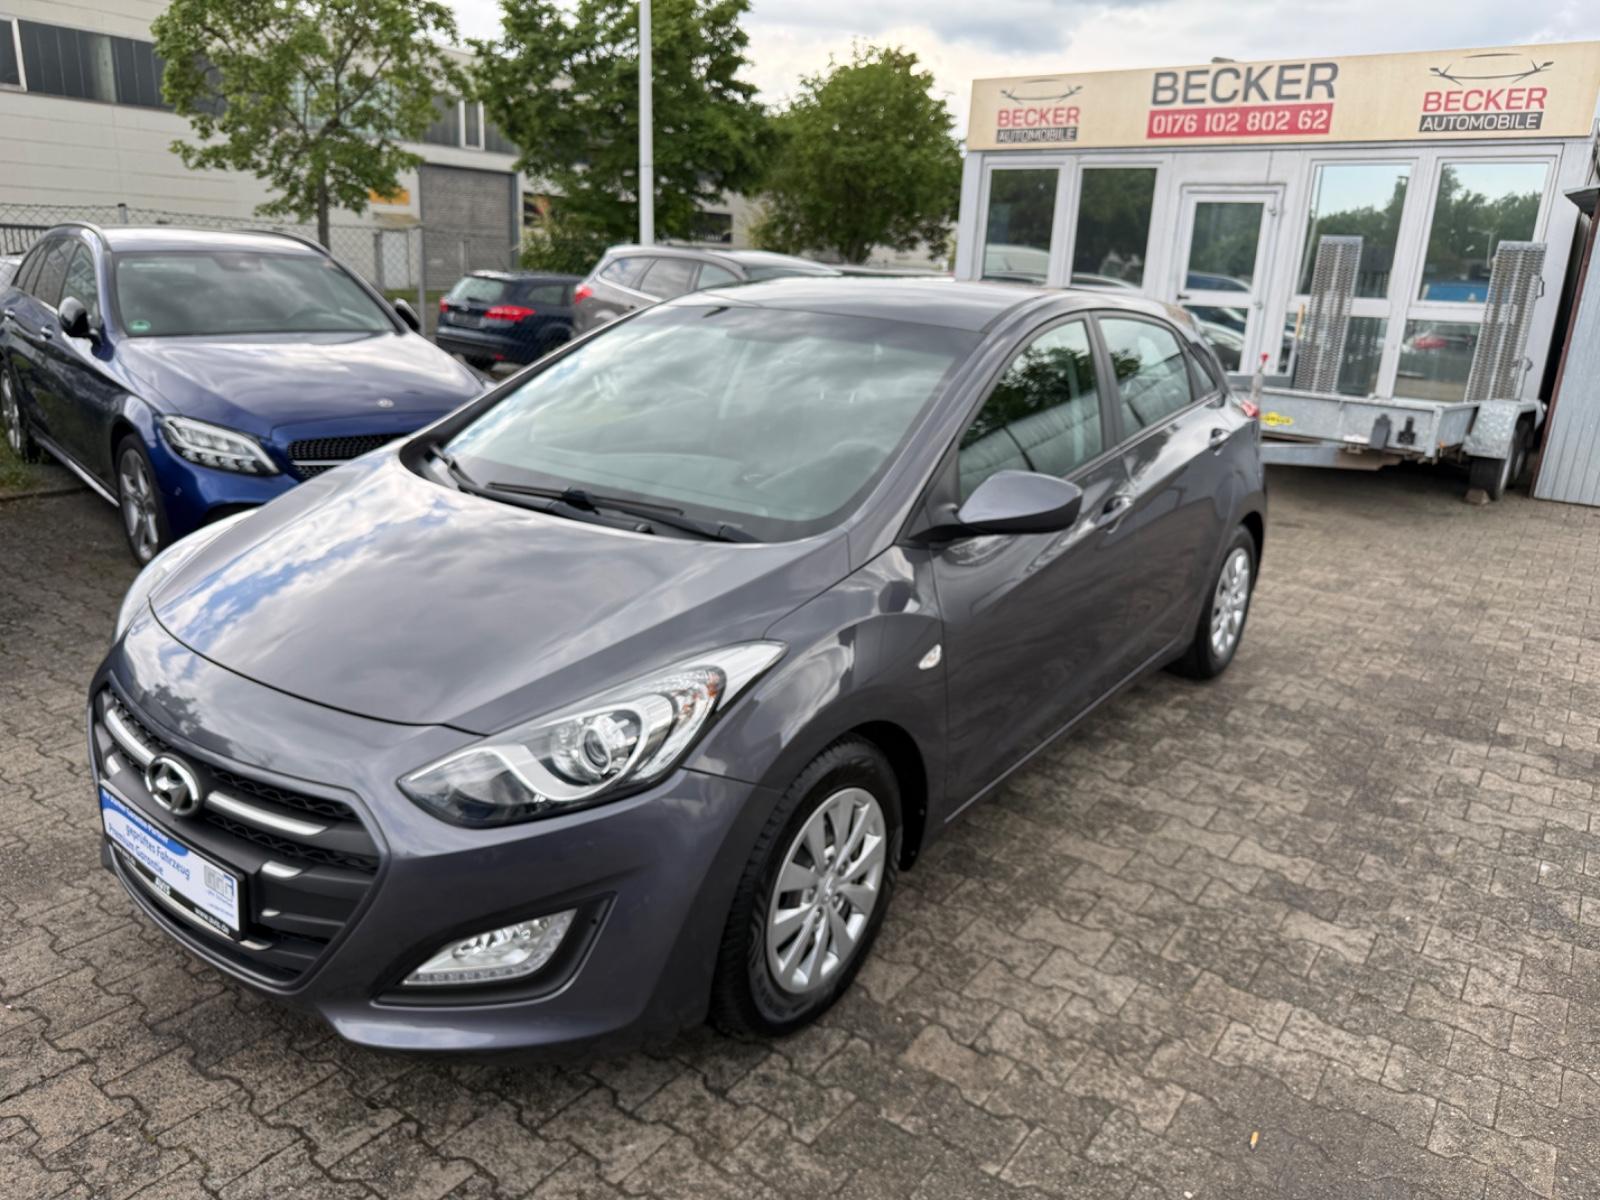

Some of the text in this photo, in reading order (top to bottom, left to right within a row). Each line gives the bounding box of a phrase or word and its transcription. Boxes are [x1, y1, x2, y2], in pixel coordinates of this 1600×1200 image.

[1152, 62, 1339, 106] BECKER
[1422, 87, 1548, 113] BECKER
[997, 107, 1080, 127] BECKER
[1152, 109, 1328, 134] 0176 102 802 62
[1421, 113, 1540, 131] AUTOMOBILE
[999, 128, 1076, 144] AUTOMOBILE
[156, 845, 191, 881] Fahrzeug
